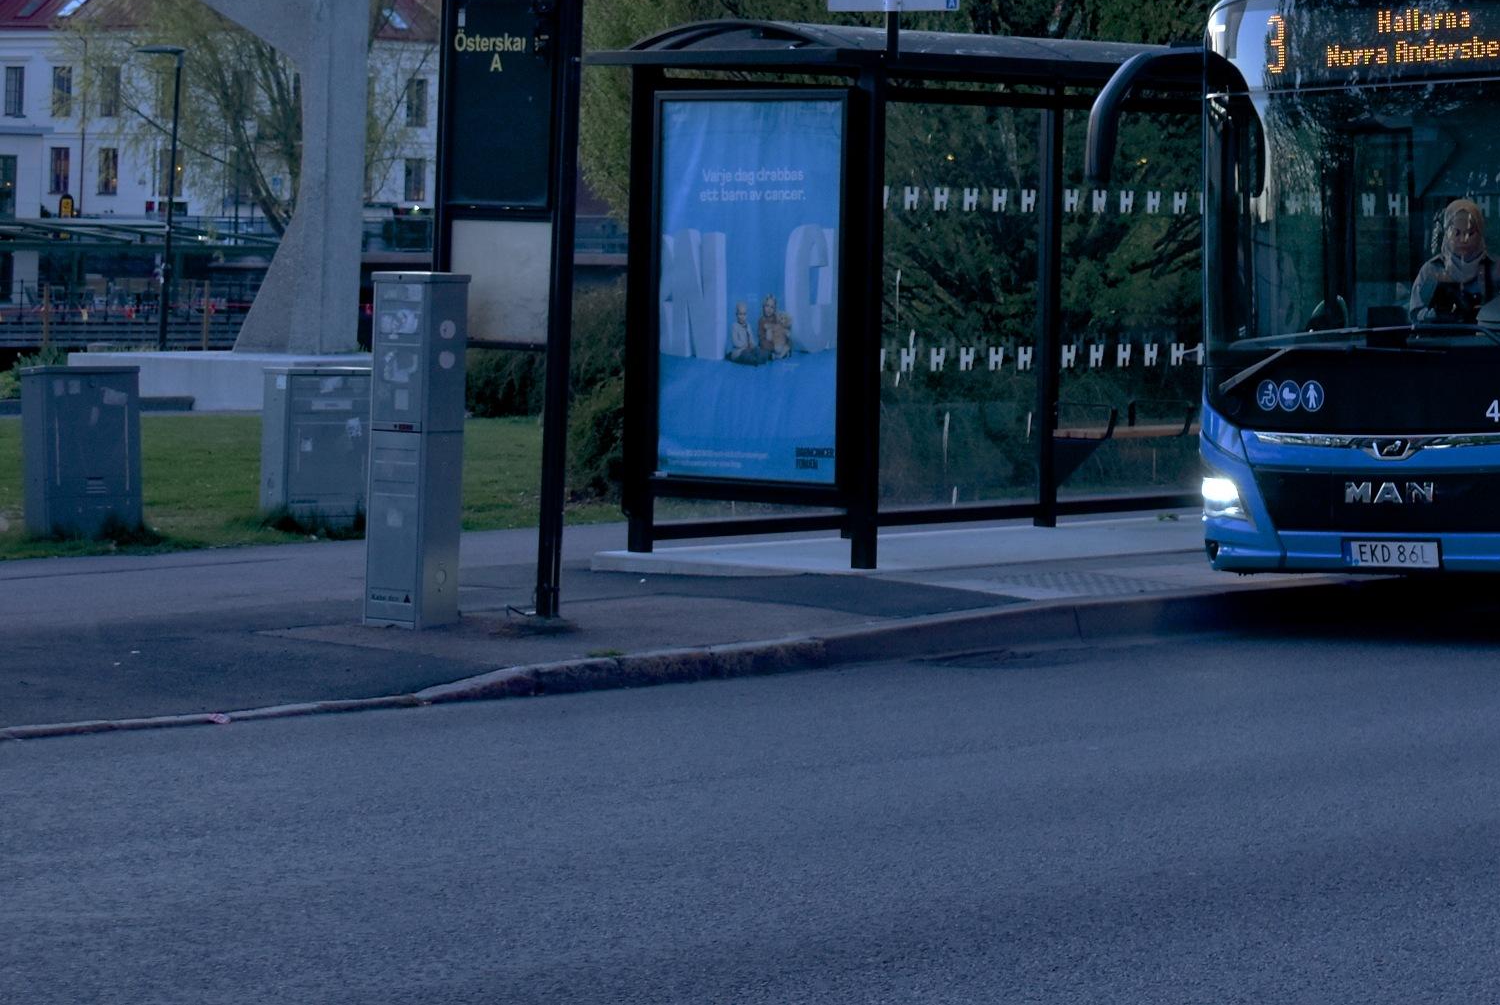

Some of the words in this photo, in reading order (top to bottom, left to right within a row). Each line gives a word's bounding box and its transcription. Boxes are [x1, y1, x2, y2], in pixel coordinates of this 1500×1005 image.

[1378, 8, 1471, 33] Hallarna
[1266, 14, 1286, 74] 3
[489, 53, 503, 72] A
[1327, 44, 1388, 68] Norra
[702, 168, 733, 187] Varje
[735, 167, 755, 186] dag
[757, 166, 805, 182] drabbas
[699, 188, 719, 202] ett
[721, 187, 748, 202] barn
[749, 190, 762, 201] av
[1344, 481, 1434, 504] MAN
[1358, 543, 1391, 563] EKD
[1397, 544, 1430, 563] 86L
